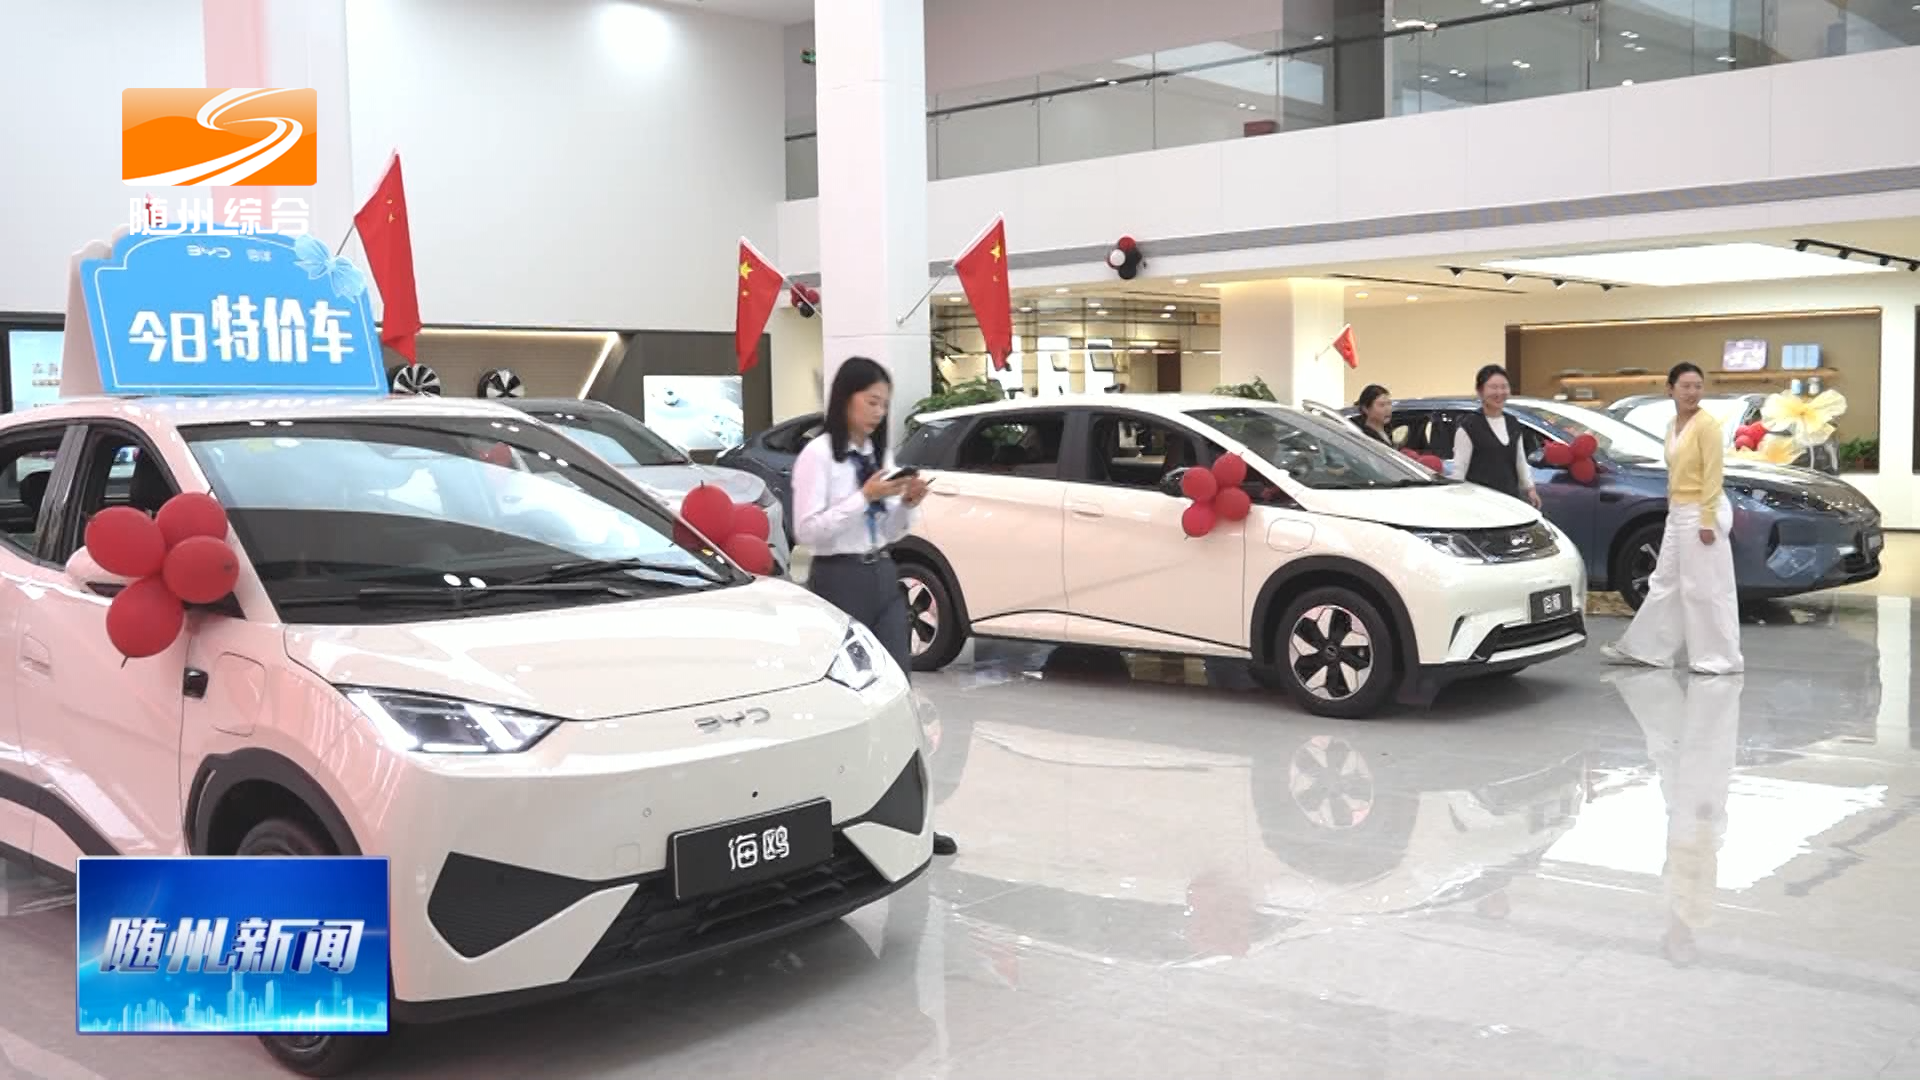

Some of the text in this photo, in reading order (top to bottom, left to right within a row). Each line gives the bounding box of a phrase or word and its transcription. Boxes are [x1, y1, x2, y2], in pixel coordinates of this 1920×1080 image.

[128, 295, 354, 363] 今日特价车
[694, 706, 771, 734] BYD
[728, 825, 790, 870] 海鸥
